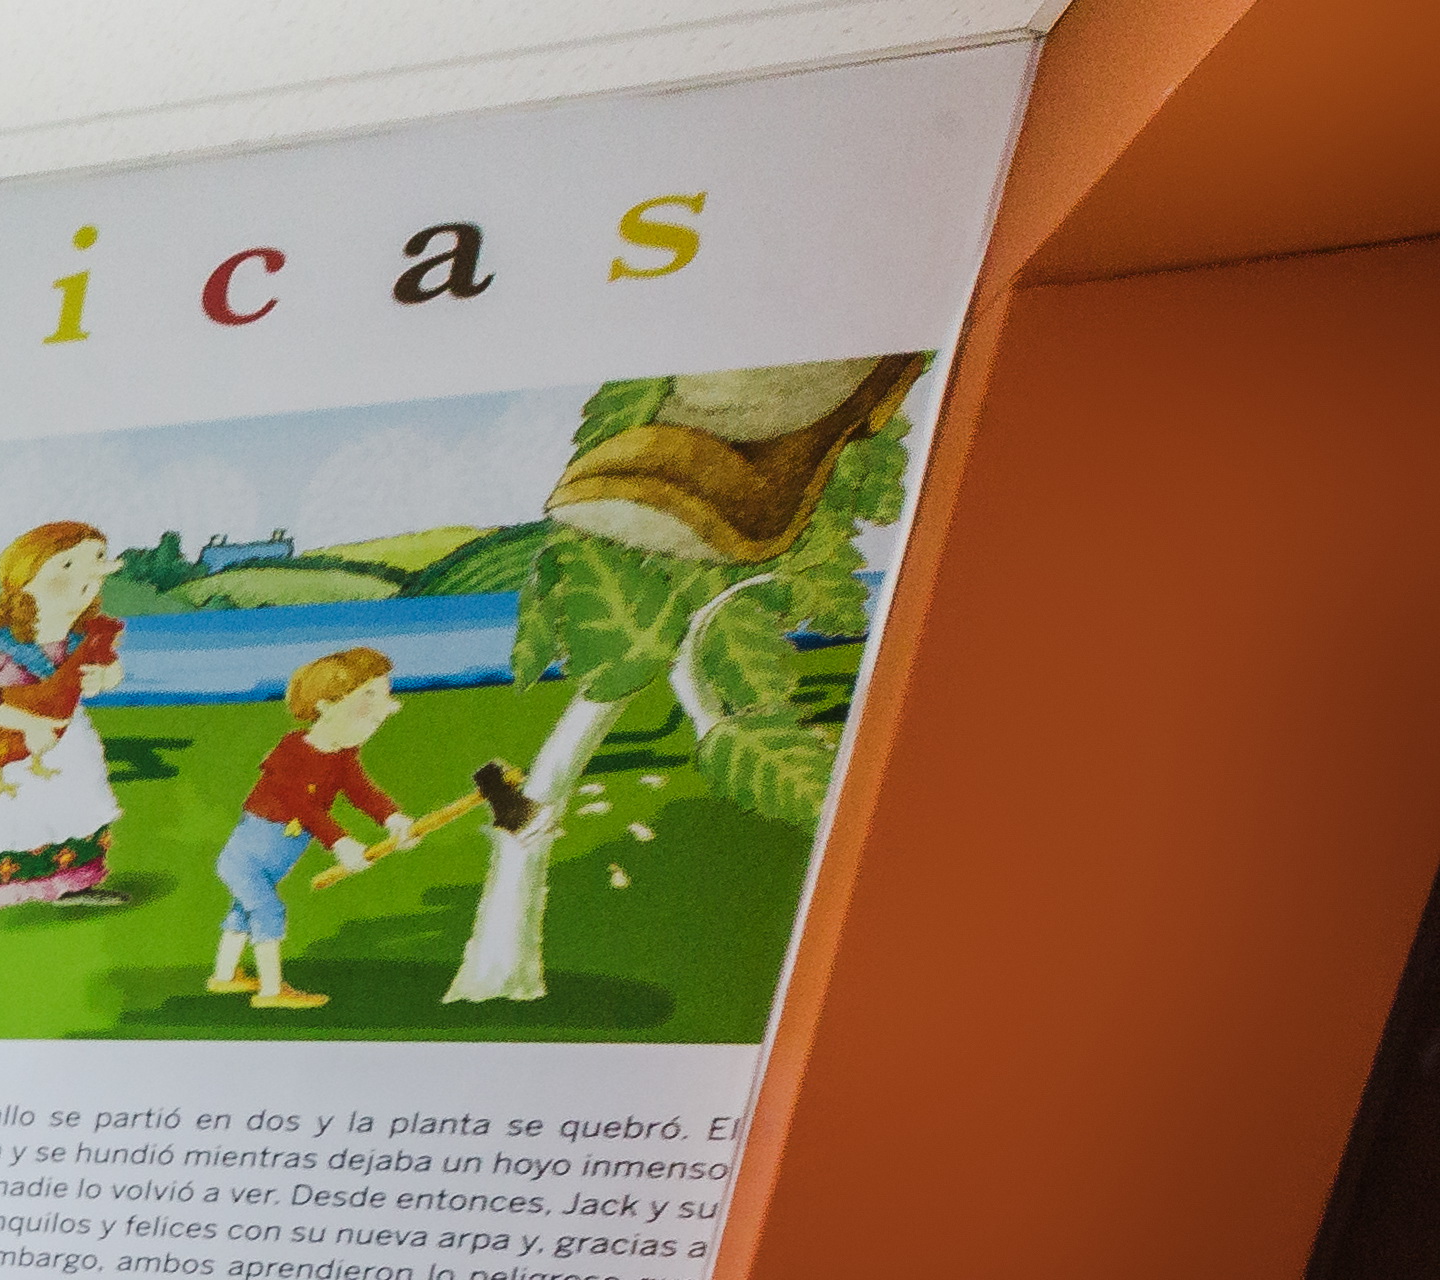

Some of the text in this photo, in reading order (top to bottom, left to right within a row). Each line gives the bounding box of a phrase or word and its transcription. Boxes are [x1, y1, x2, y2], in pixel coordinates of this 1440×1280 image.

[97, 1219, 118, 1242] y
[125, 1214, 218, 1240] felices
[227, 1223, 282, 1242] con
[290, 1225, 327, 1244] su
[335, 1227, 429, 1248] nueva
[436, 1231, 512, 1256] arpa
[515, 1234, 544, 1258] y,
[551, 1232, 679, 1260] gracias
[686, 1236, 717, 1267] a
